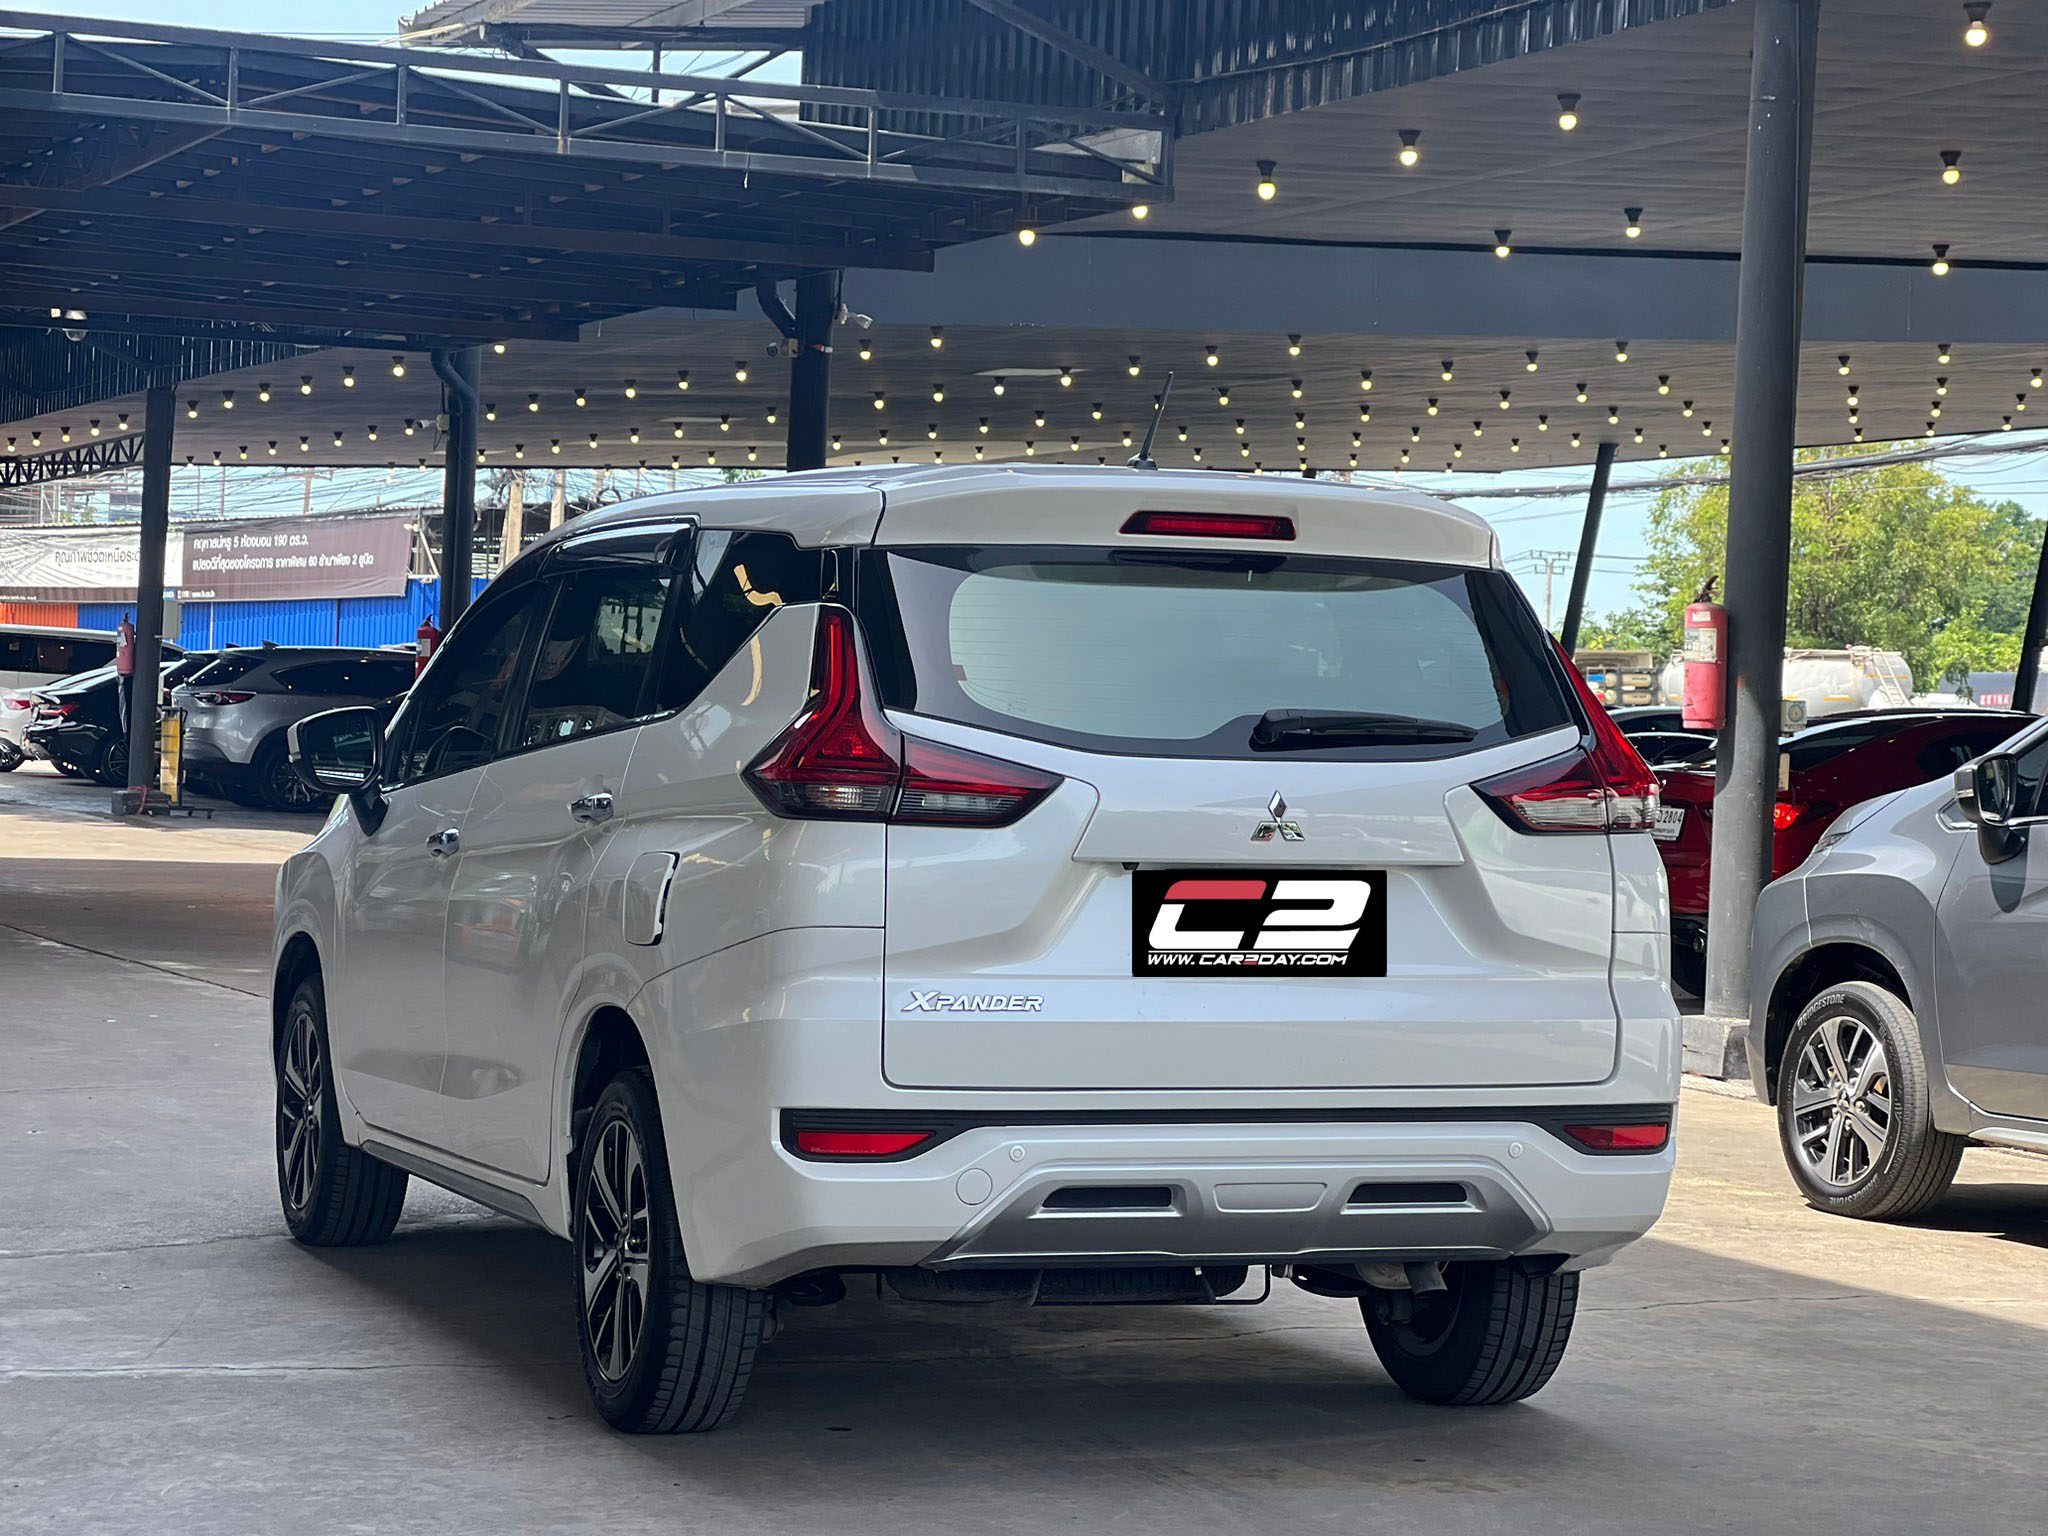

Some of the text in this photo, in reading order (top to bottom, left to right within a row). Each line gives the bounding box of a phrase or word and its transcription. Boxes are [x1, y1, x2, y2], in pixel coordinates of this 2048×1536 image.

[233, 536, 239, 548] 5
[274, 534, 288, 547] 190
[308, 555, 318, 567] 60
[352, 554, 358, 565] 2
[1663, 810, 1684, 824] 2804
[901, 990, 1045, 1012] XPANDER
